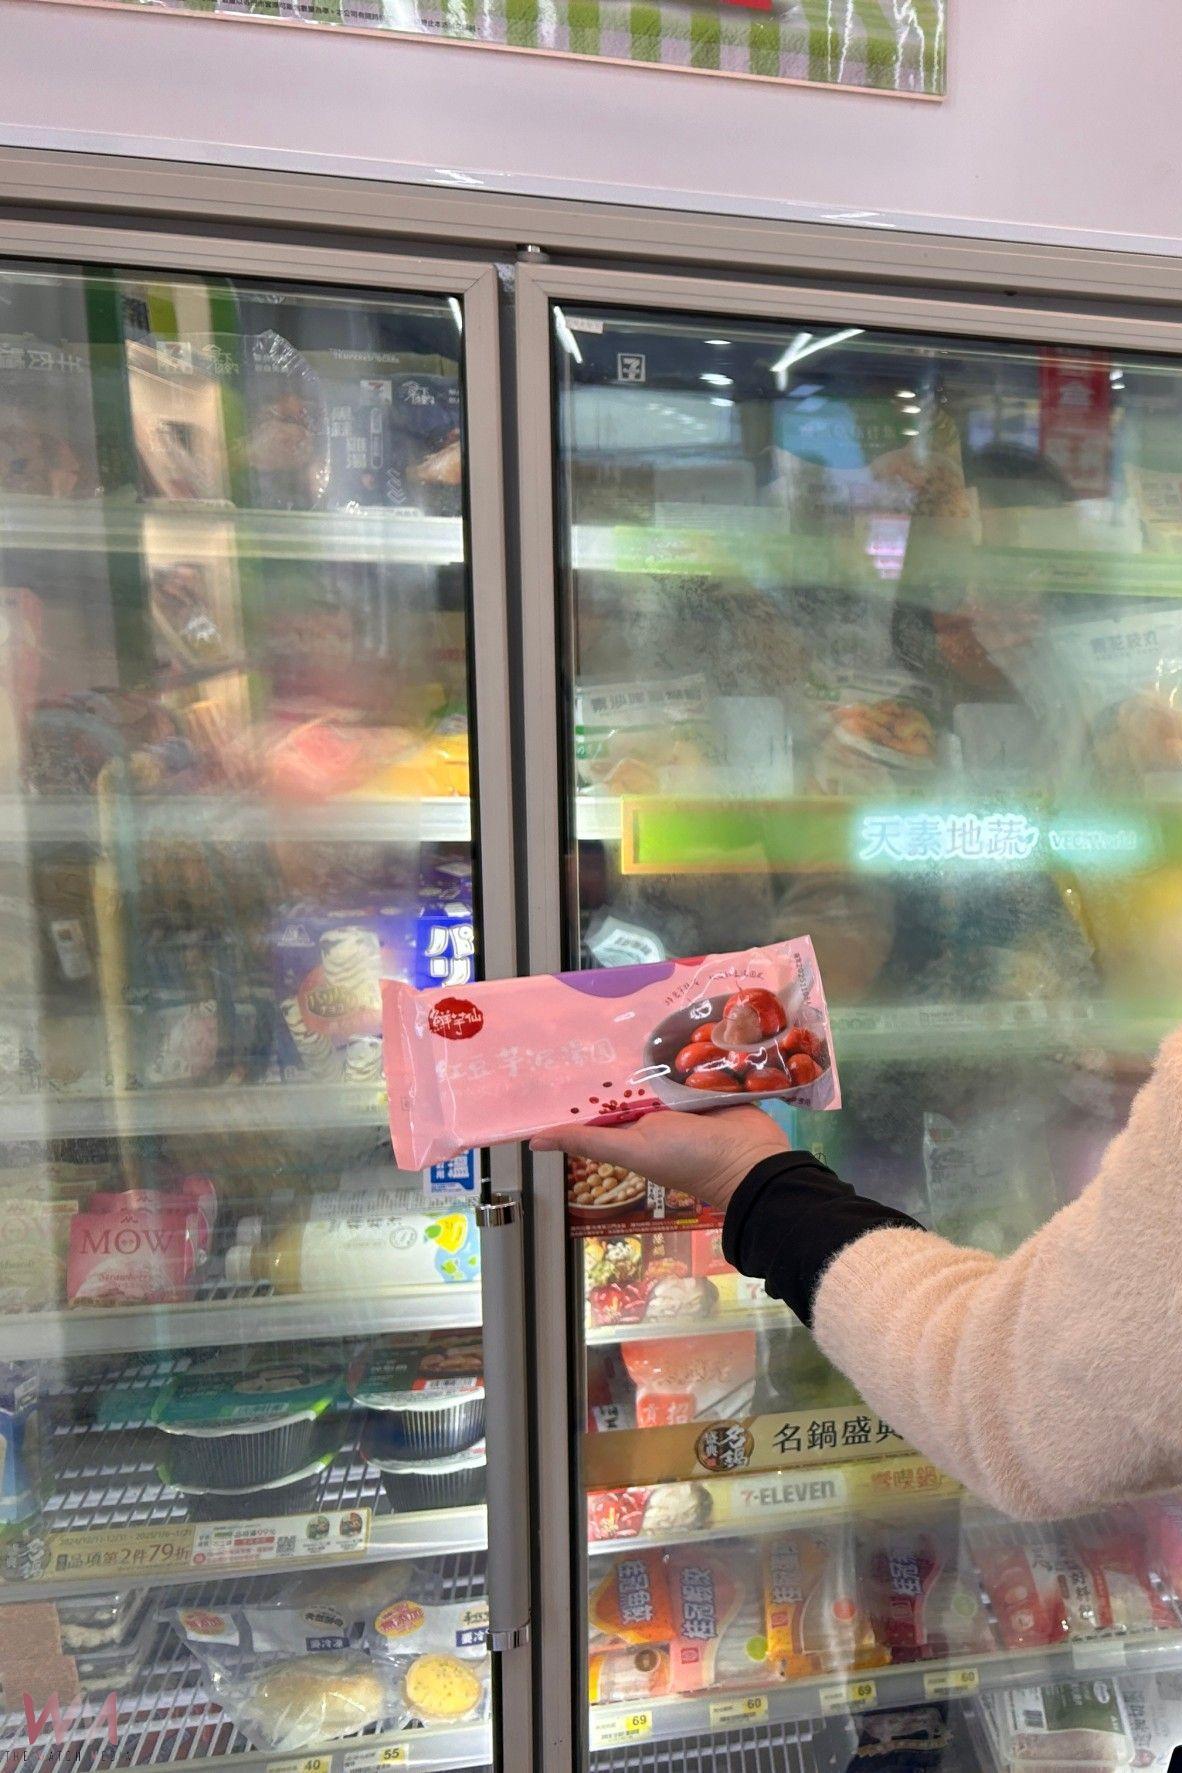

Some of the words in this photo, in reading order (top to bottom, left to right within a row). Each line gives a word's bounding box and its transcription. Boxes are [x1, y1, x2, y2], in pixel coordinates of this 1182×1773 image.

[864, 814, 1024, 858] 天素地蔬
[432, 1008, 482, 1036] 鮮芋仙
[80, 1228, 172, 1255] MOW
[858, 1685, 872, 1697] 69
[632, 1715, 647, 1726] 69
[383, 1748, 399, 1760] 55
[305, 1760, 320, 1770] 40
